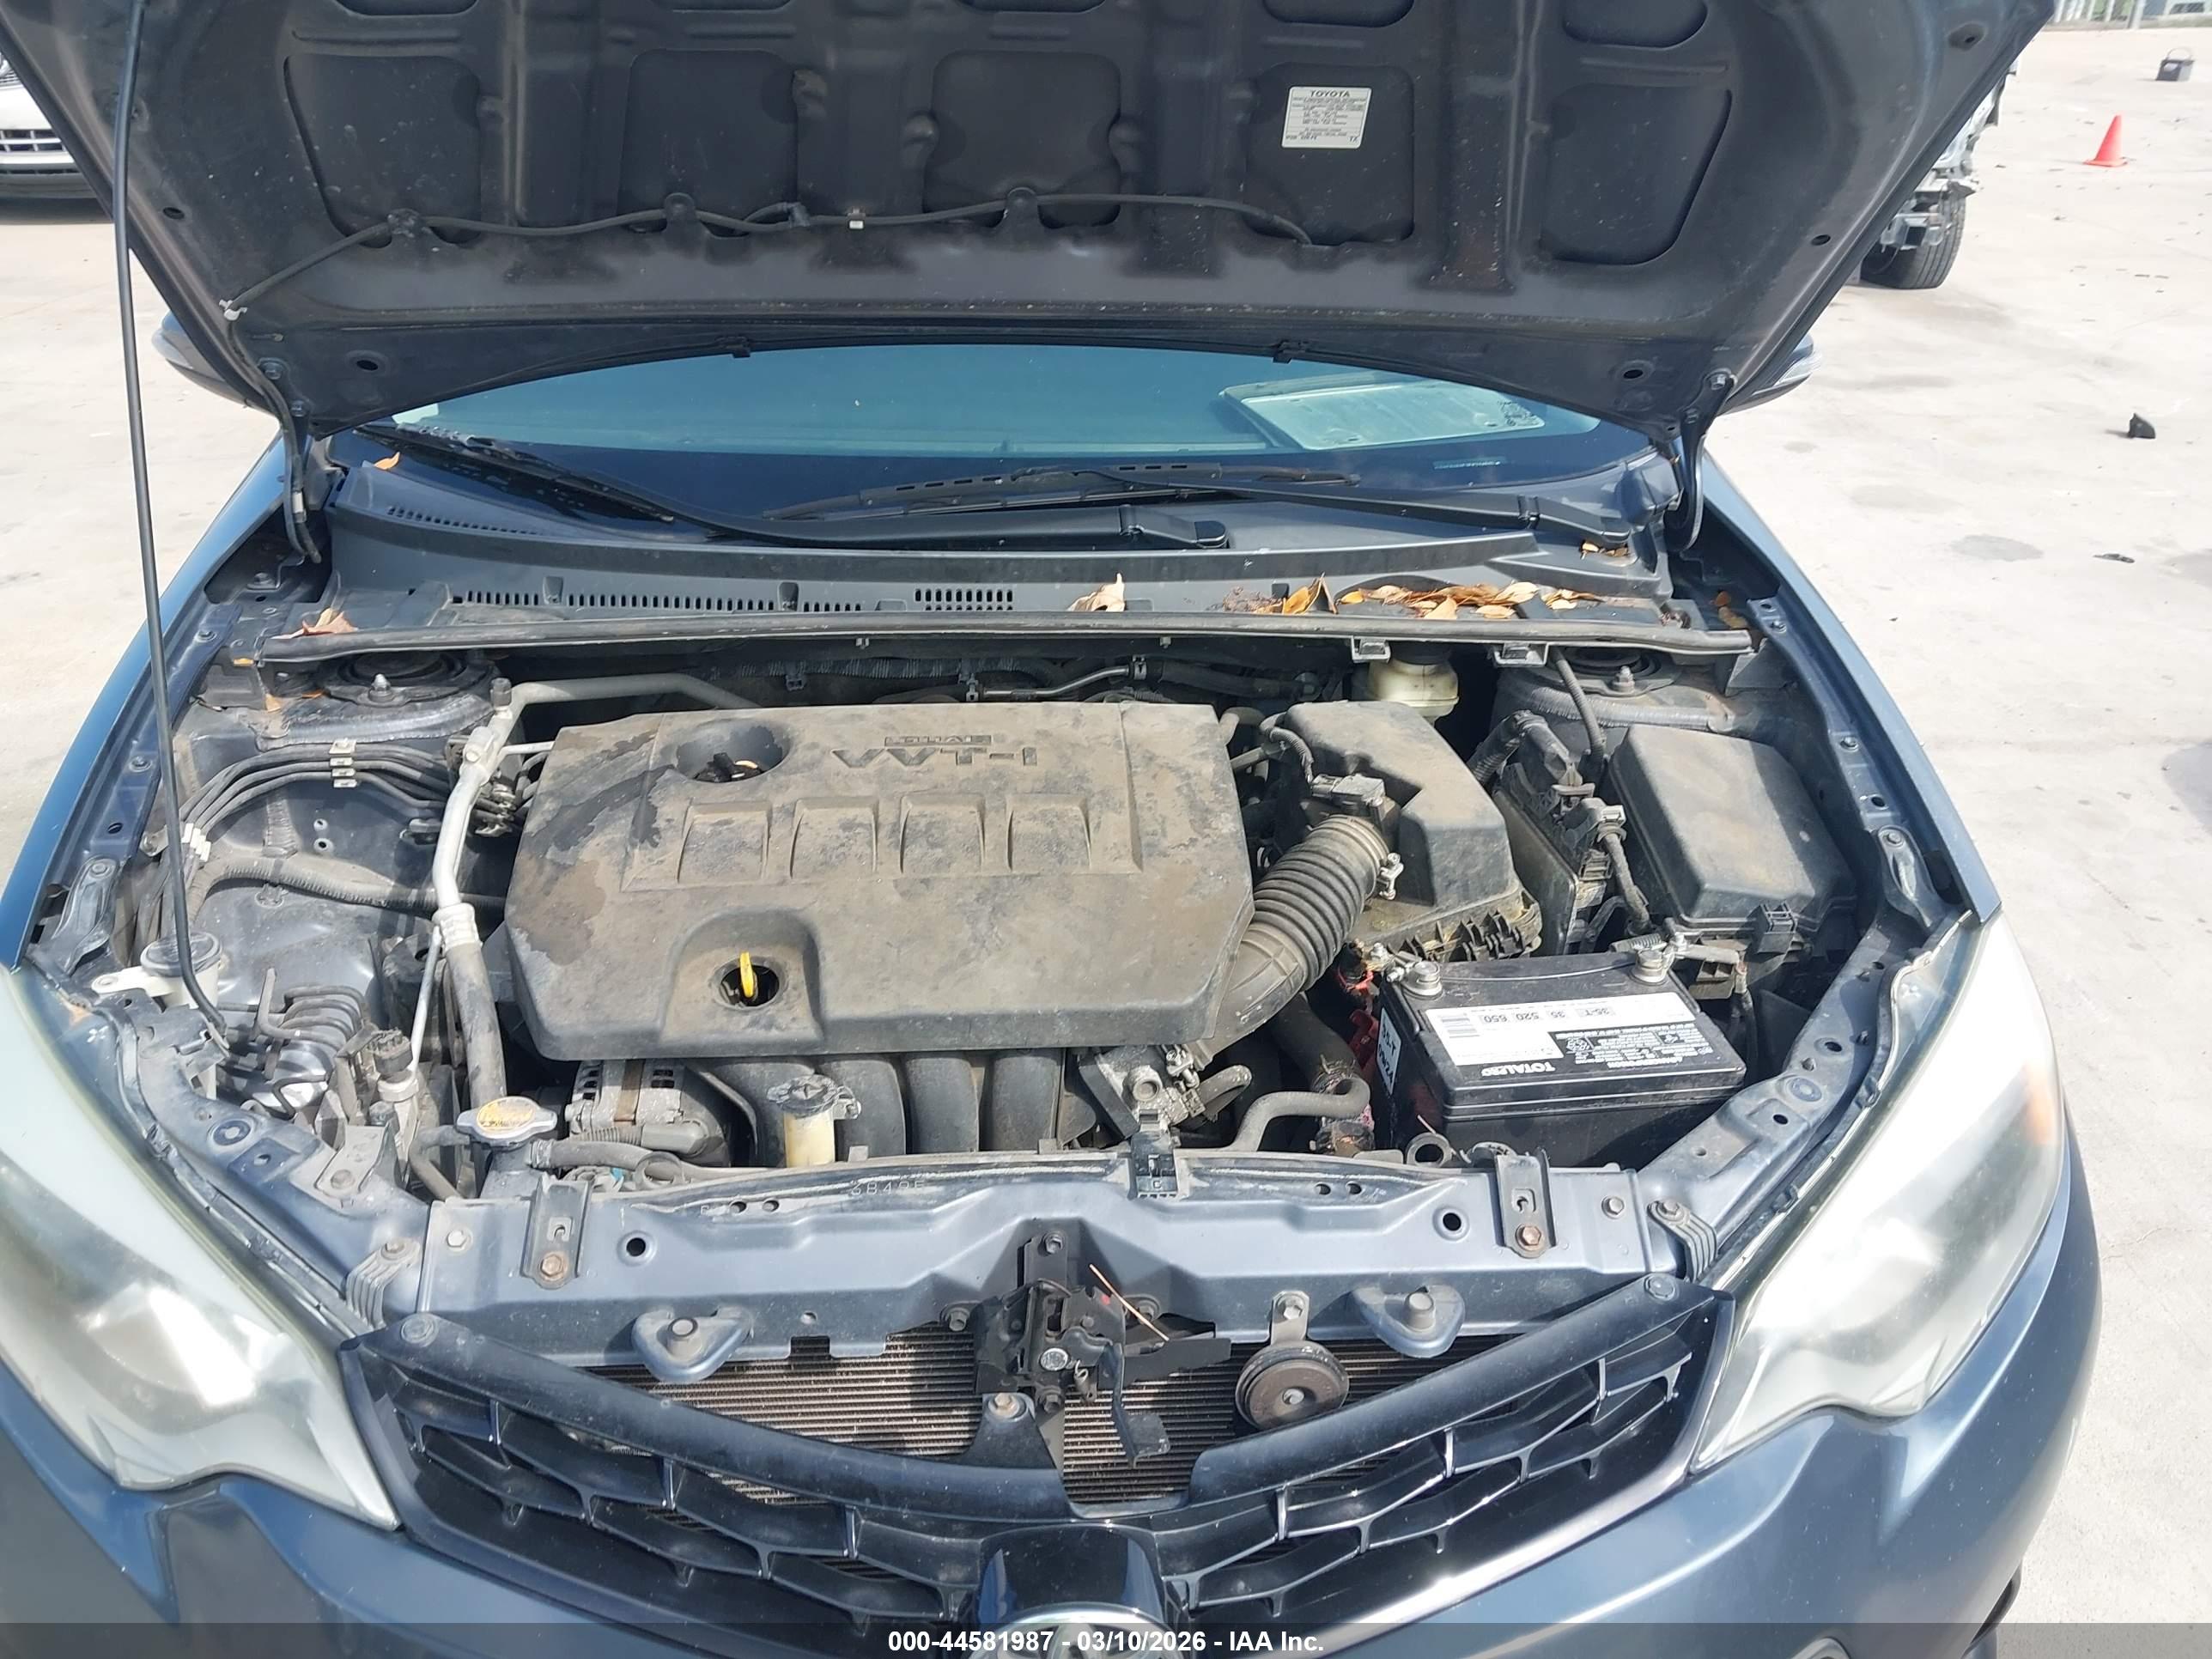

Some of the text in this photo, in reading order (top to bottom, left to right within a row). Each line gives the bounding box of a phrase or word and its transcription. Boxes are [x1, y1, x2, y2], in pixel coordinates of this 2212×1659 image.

[1483, 1013, 1508, 1024] 650
[1516, 1012, 1540, 1021] 520
[1550, 1010, 1566, 1019] 35
